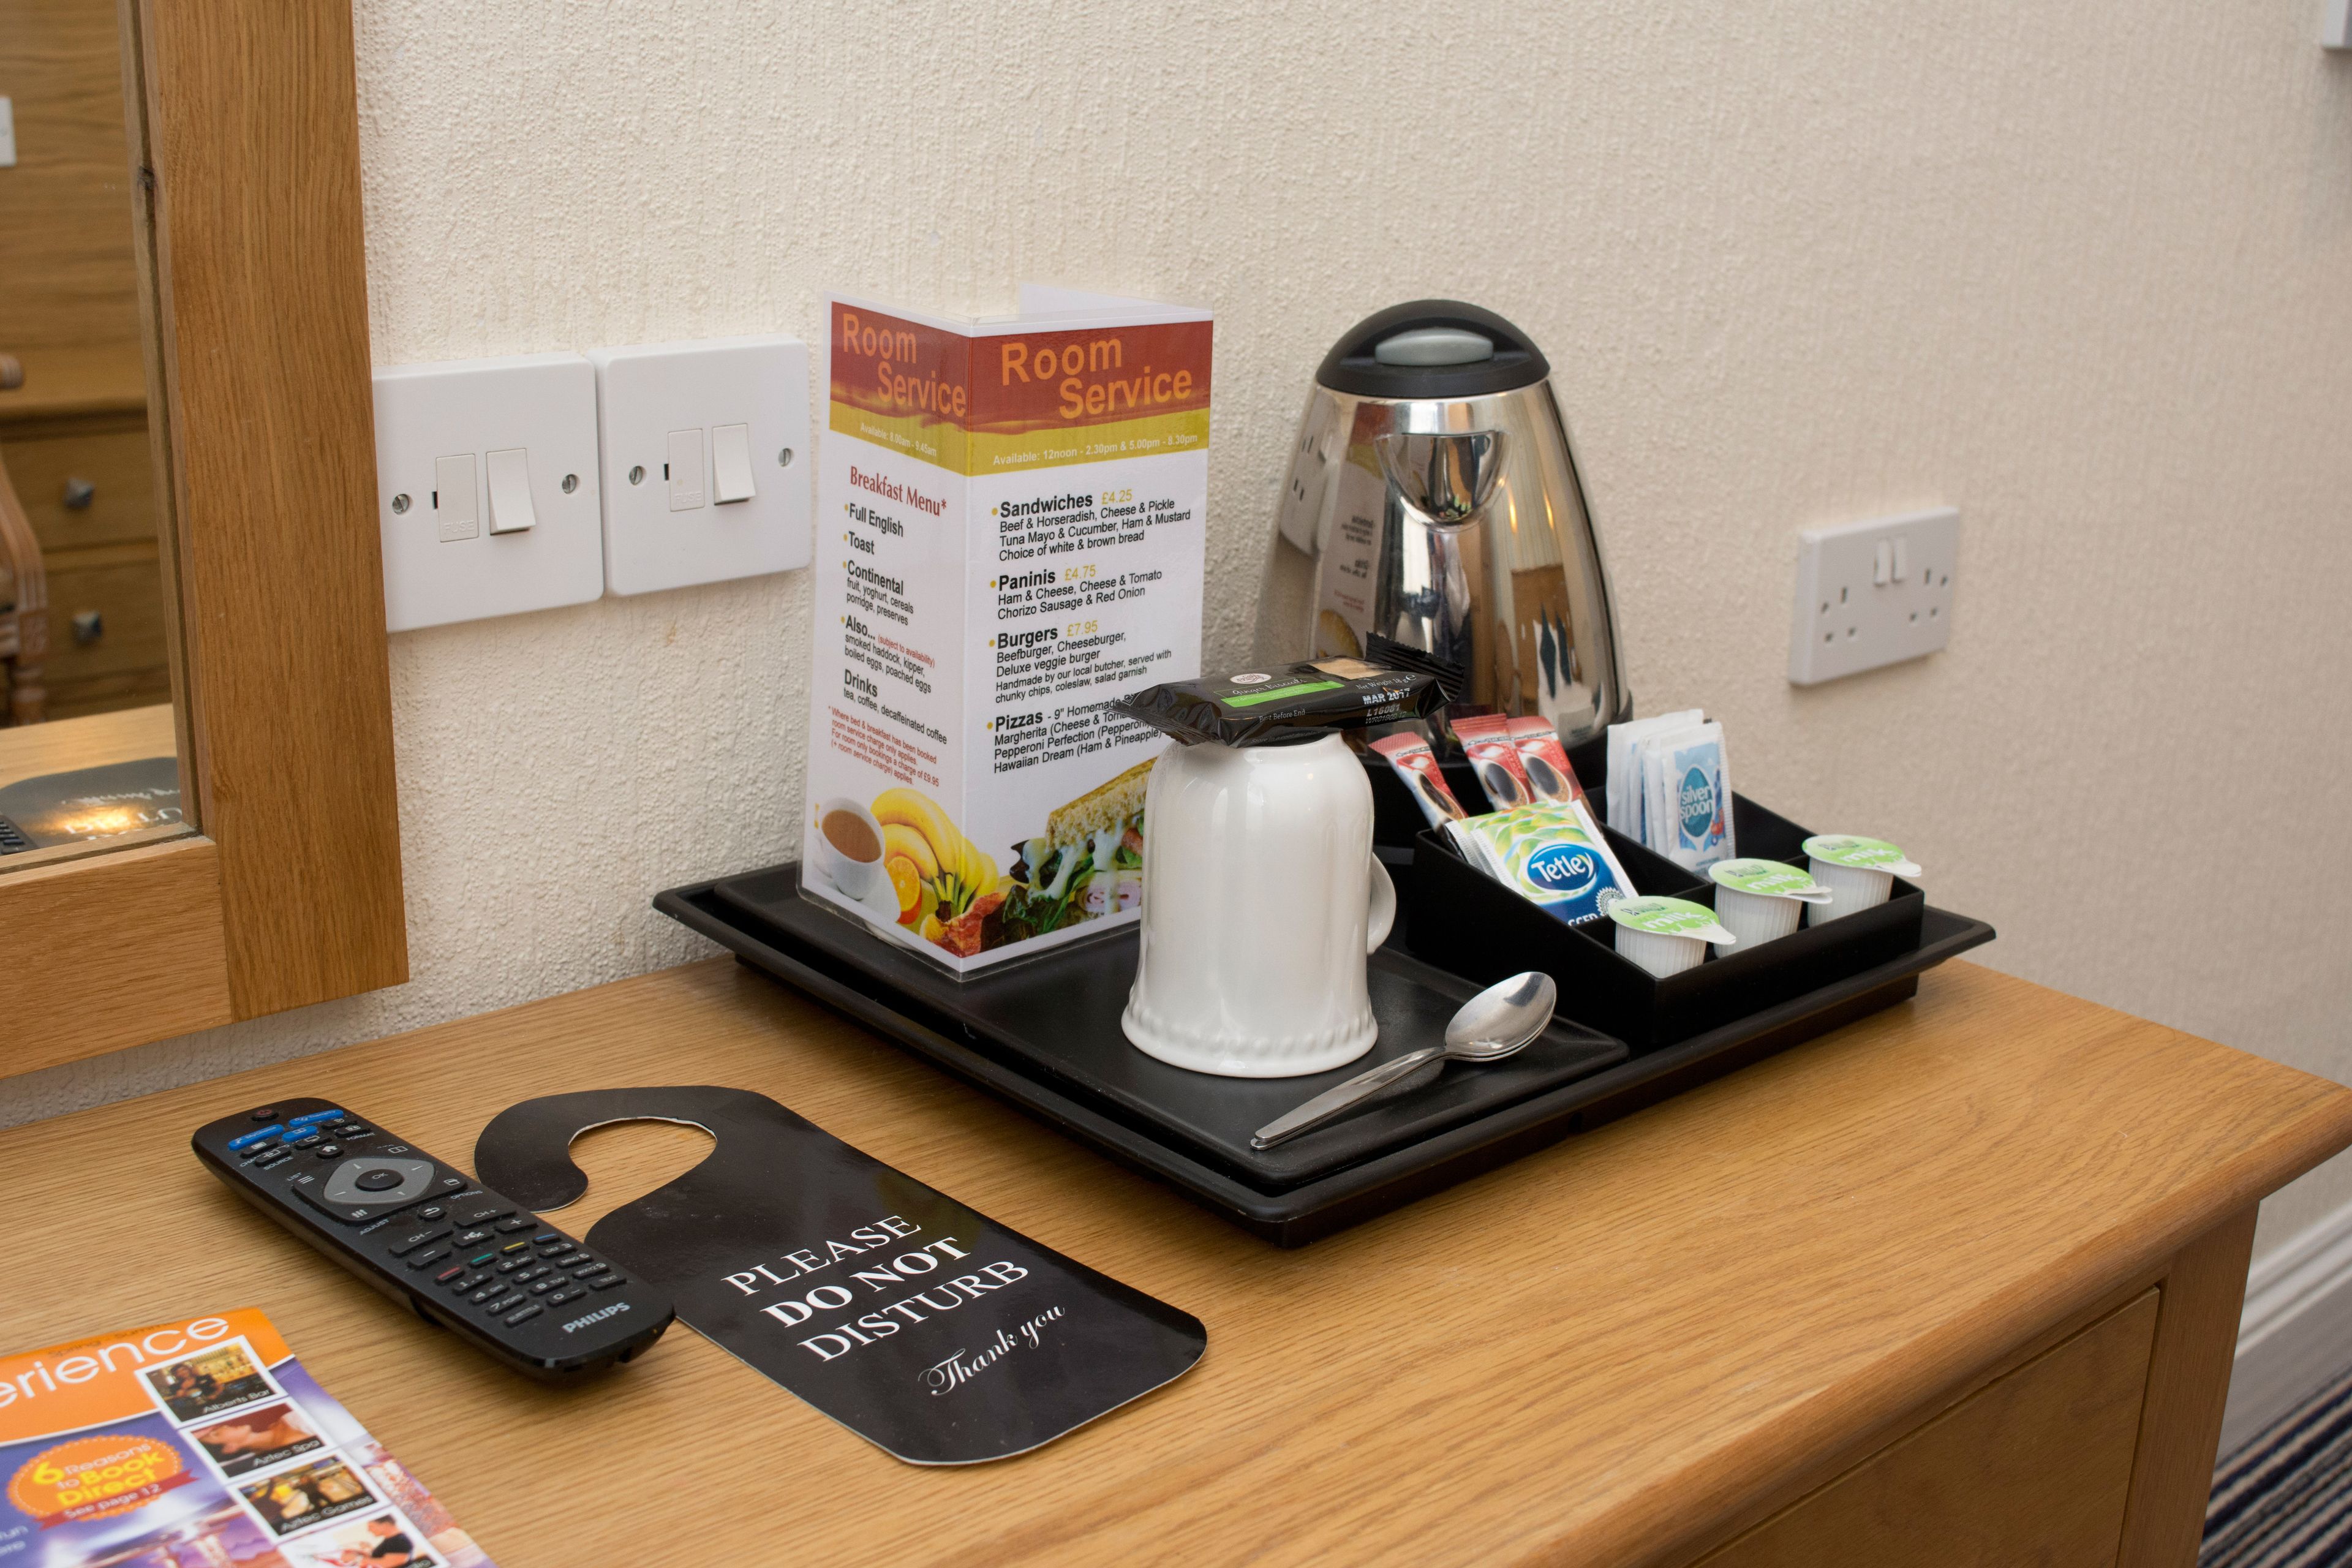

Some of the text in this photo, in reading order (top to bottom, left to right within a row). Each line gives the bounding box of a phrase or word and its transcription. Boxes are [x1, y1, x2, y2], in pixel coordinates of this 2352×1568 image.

[842, 313, 918, 364] Room
[1001, 337, 1123, 386] Room
[877, 361, 967, 418] Service
[1058, 366, 1193, 419] Service
[860, 423, 937, 457] Available: 8.00am 9.45am
[993, 434, 1198, 466] Available: 12noon 2.30pm & 5.00pm 8.30pm
[675, 491, 702, 503] FUSE
[850, 466, 903, 502] Breakfast
[850, 503, 903, 537] Full English
[1000, 489, 1133, 518] Sandwiches £4.25
[1000, 499, 1175, 533] Beef & Horseradish, Cheese & Pickle
[443, 520, 475, 533] FUSE
[848, 530, 875, 555] Toast
[1000, 510, 1191, 547] Tuna Mayo & Cucumber, Ham & Mustard
[999, 530, 1145, 562] Choice of white & brown bread
[848, 560, 903, 596] Continental
[998, 564, 1096, 591] Paninis £4.75
[998, 570, 1163, 606] Ham & Cheese, Cheese & Tomato
[846, 593, 908, 626] porridge, preserves
[847, 577, 914, 614] fruit, yoghurt, cereals
[997, 586, 1145, 620] Chorizo Sausage & Red Onion
[845, 614, 935, 668] Also... (subject to availability)
[997, 620, 1098, 649] Burgers £7.95
[997, 631, 1126, 663] Beefburger, Cheeseburger,
[845, 634, 925, 678] smoked haddock, kipper,
[845, 645, 931, 693] boiled eggs, poached eggs
[996, 649, 1101, 677] Deluxe veggie burger
[996, 649, 1172, 692] Handmade by our local butcher, served with
[845, 668, 878, 698] Drinks
[995, 665, 1147, 704] chunky chips, coleslaw, salad garnish
[1362, 688, 1411, 705] MAR 2017
[1368, 679, 1393, 688] Weight
[843, 687, 947, 744] tea, coffee, decaffeinated coffee
[995, 712, 1044, 732] Pizzas
[1054, 707, 1065, 720] 9"
[1066, 697, 1121, 718] Homemade
[1273, 711, 1293, 720] Before
[1366, 703, 1401, 717] L16081
[994, 714, 1100, 747] Margherita (Cheese &
[994, 729, 1095, 760] Pepperoni Perfection
[994, 728, 1162, 774] Hawaiian Dream (Ham & Pineapple)
[1682, 784, 1711, 805] silver
[1680, 800, 1714, 823] spoon
[1531, 852, 1594, 882] Tetley
[1841, 848, 1894, 862] milk
[1747, 874, 1804, 889] milk
[1642, 912, 1703, 929] milk
[263, 1156, 294, 1171] SOURCE
[450, 1189, 483, 1200] OPTIONS
[360, 1218, 390, 1235] ADJUST
[720, 1215, 922, 1297] PLEASE
[760, 1237, 972, 1329] DO NOT
[561, 1302, 631, 1333] PHILIPS
[796, 1261, 1029, 1362] DISTURB
[917, 1303, 1066, 1396] Thank you
[202, 1389, 271, 1415] Alberts Bar
[32, 1443, 152, 1485] 6 Reasons
[253, 1439, 322, 1467] Aztec Spa
[56, 1450, 166, 1490] to Book
[56, 1468, 157, 1507] Direct
[63, 1483, 162, 1519] See page 12
[280, 1496, 373, 1532] Aztec Games
